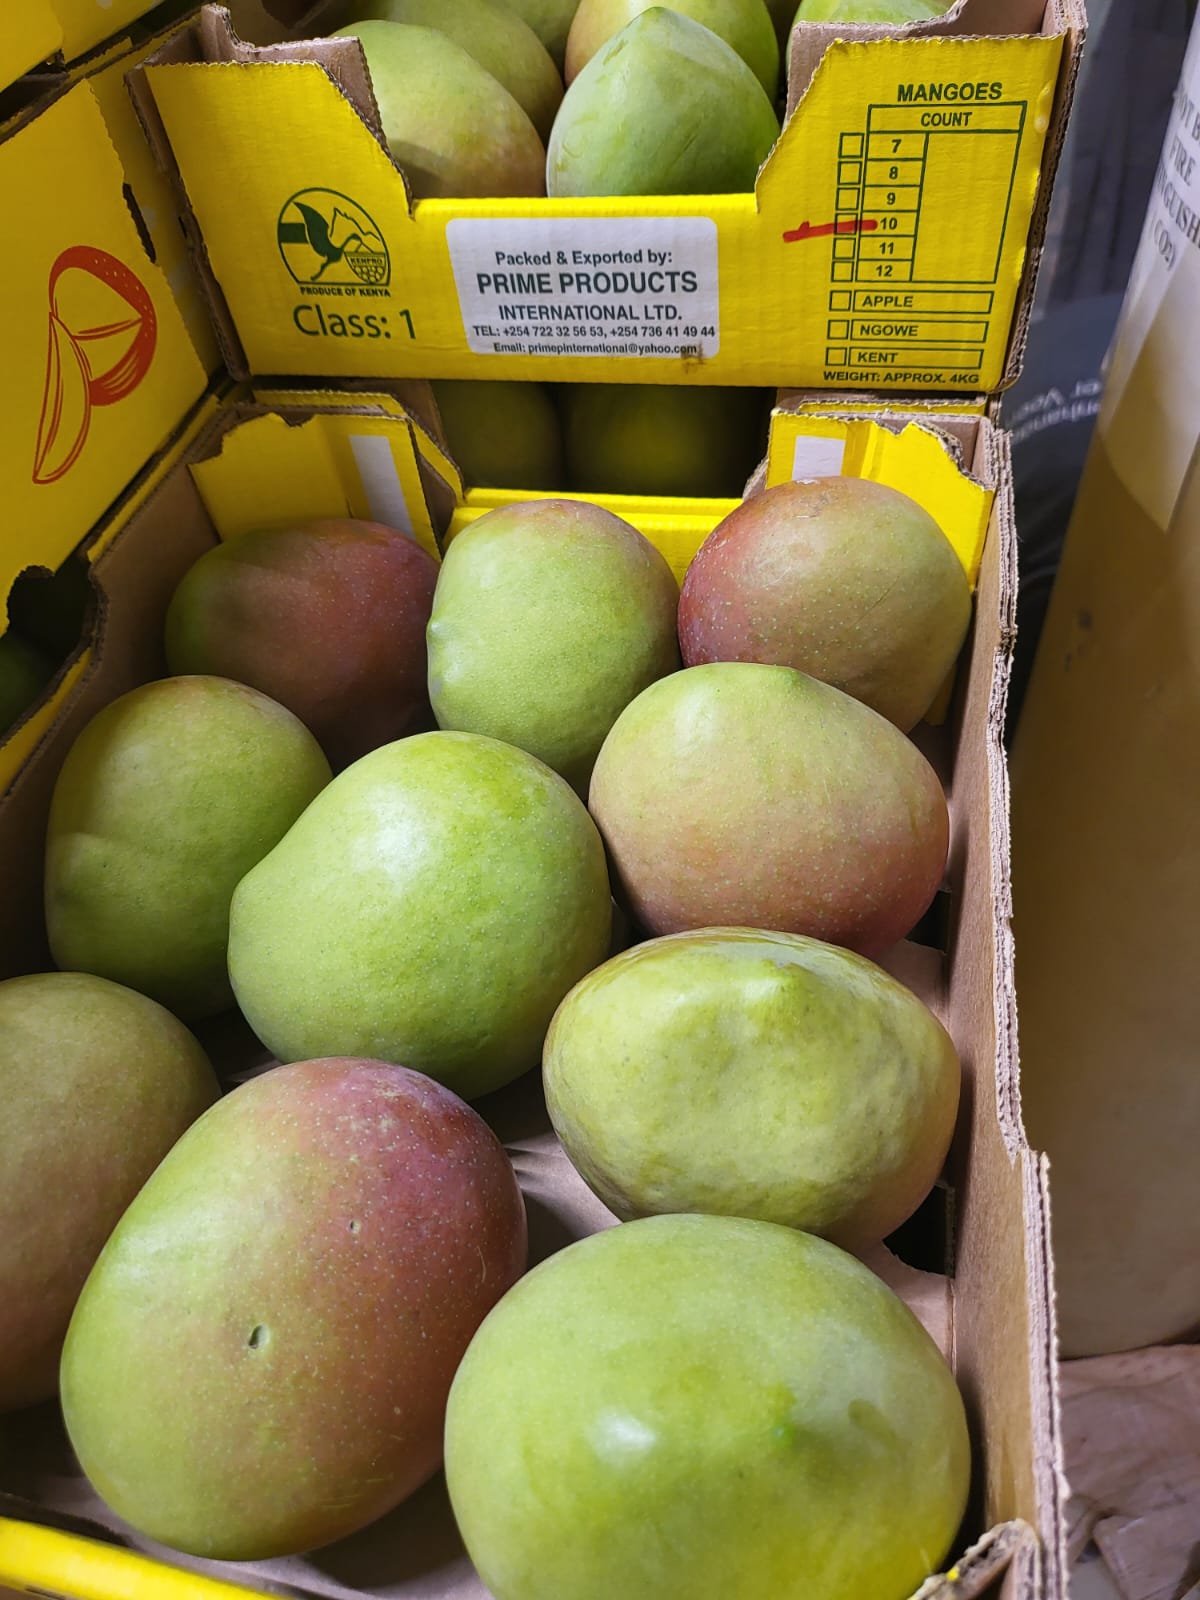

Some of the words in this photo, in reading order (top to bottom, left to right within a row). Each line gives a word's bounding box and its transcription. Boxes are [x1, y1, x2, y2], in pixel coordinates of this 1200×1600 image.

[897, 82, 1003, 101] MANGOES
[920, 112, 972, 126] COUNT
[891, 140, 902, 152] 7
[1169, 135, 1196, 187] FIRE
[888, 167, 899, 179] 8
[886, 192, 896, 205] 9
[880, 218, 898, 230] 10
[879, 243, 894, 254] 11
[495, 251, 551, 266] Packed
[556, 251, 568, 264] &
[572, 249, 642, 267] Exported
[648, 249, 672, 266] by:
[876, 266, 893, 277] 12
[476, 273, 553, 294] PRIME
[559, 271, 698, 294] PRODUCTS
[300, 287, 343, 296] PRODUCE
[345, 287, 356, 296] OF
[359, 287, 391, 297] KENYA
[862, 295, 913, 308] APPLE
[499, 305, 640, 321] INTERNATIONAL
[644, 305, 682, 320] LTD.
[293, 304, 392, 339] Class:
[399, 309, 416, 339] 1
[472, 326, 500, 337] TEL:
[503, 326, 530, 337] +254
[533, 326, 553, 337] 722
[556, 326, 570, 337] 32
[573, 326, 586, 337] 56
[589, 326, 607, 339] 53,
[610, 326, 638, 337] +254
[641, 326, 662, 337] 736
[665, 326, 679, 337] 41
[683, 326, 698, 337] 49
[701, 326, 715, 337] 44
[859, 325, 918, 336] NGOWE
[493, 342, 526, 353] Email:
[858, 352, 898, 363] KENT
[824, 371, 880, 382] WEIGHT:
[884, 372, 946, 383] APPROX.
[950, 373, 979, 384] 4KG
